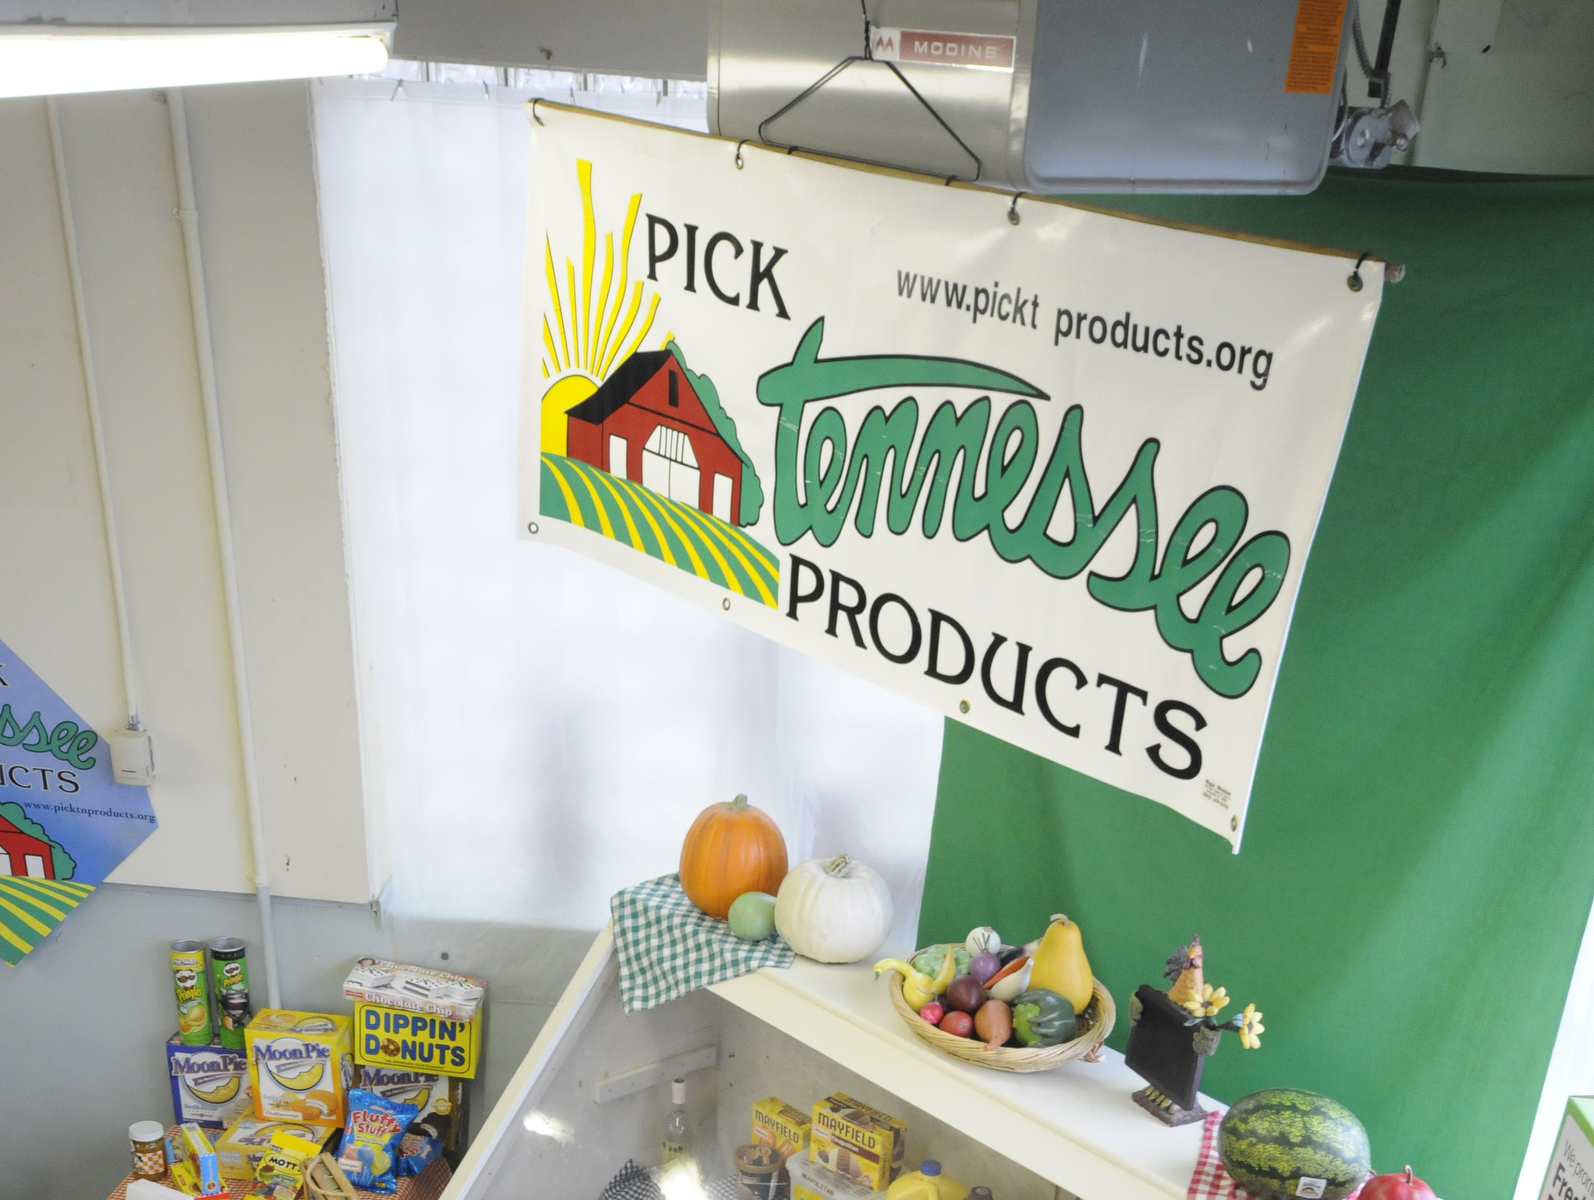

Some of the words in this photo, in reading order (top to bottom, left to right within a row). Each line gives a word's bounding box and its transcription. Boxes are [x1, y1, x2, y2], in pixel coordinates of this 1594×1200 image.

[914, 40, 997, 59] MODINE
[644, 213, 791, 320] PICK
[896, 268, 1041, 331] www.pickt
[1054, 308, 1275, 390] products.org
[786, 553, 1208, 780] PRODUCTS
[23, 801, 156, 824] www.picktnproducts.org
[379, 960, 438, 976] Chocolate
[439, 969, 467, 982] Chip
[365, 991, 424, 1011] Chocolate
[426, 1003, 453, 1018] Chip
[365, 1009, 466, 1041] DIPPIN'
[171, 1054, 247, 1075] MoonPie
[252, 1042, 331, 1064] MoonPie
[352, 1110, 402, 1134] Fluffy
[357, 1123, 386, 1137] Stuff
[755, 1109, 800, 1144] MAYFIELD
[818, 1112, 876, 1149] MAYFIELD
[1563, 1139, 1576, 1168] We
